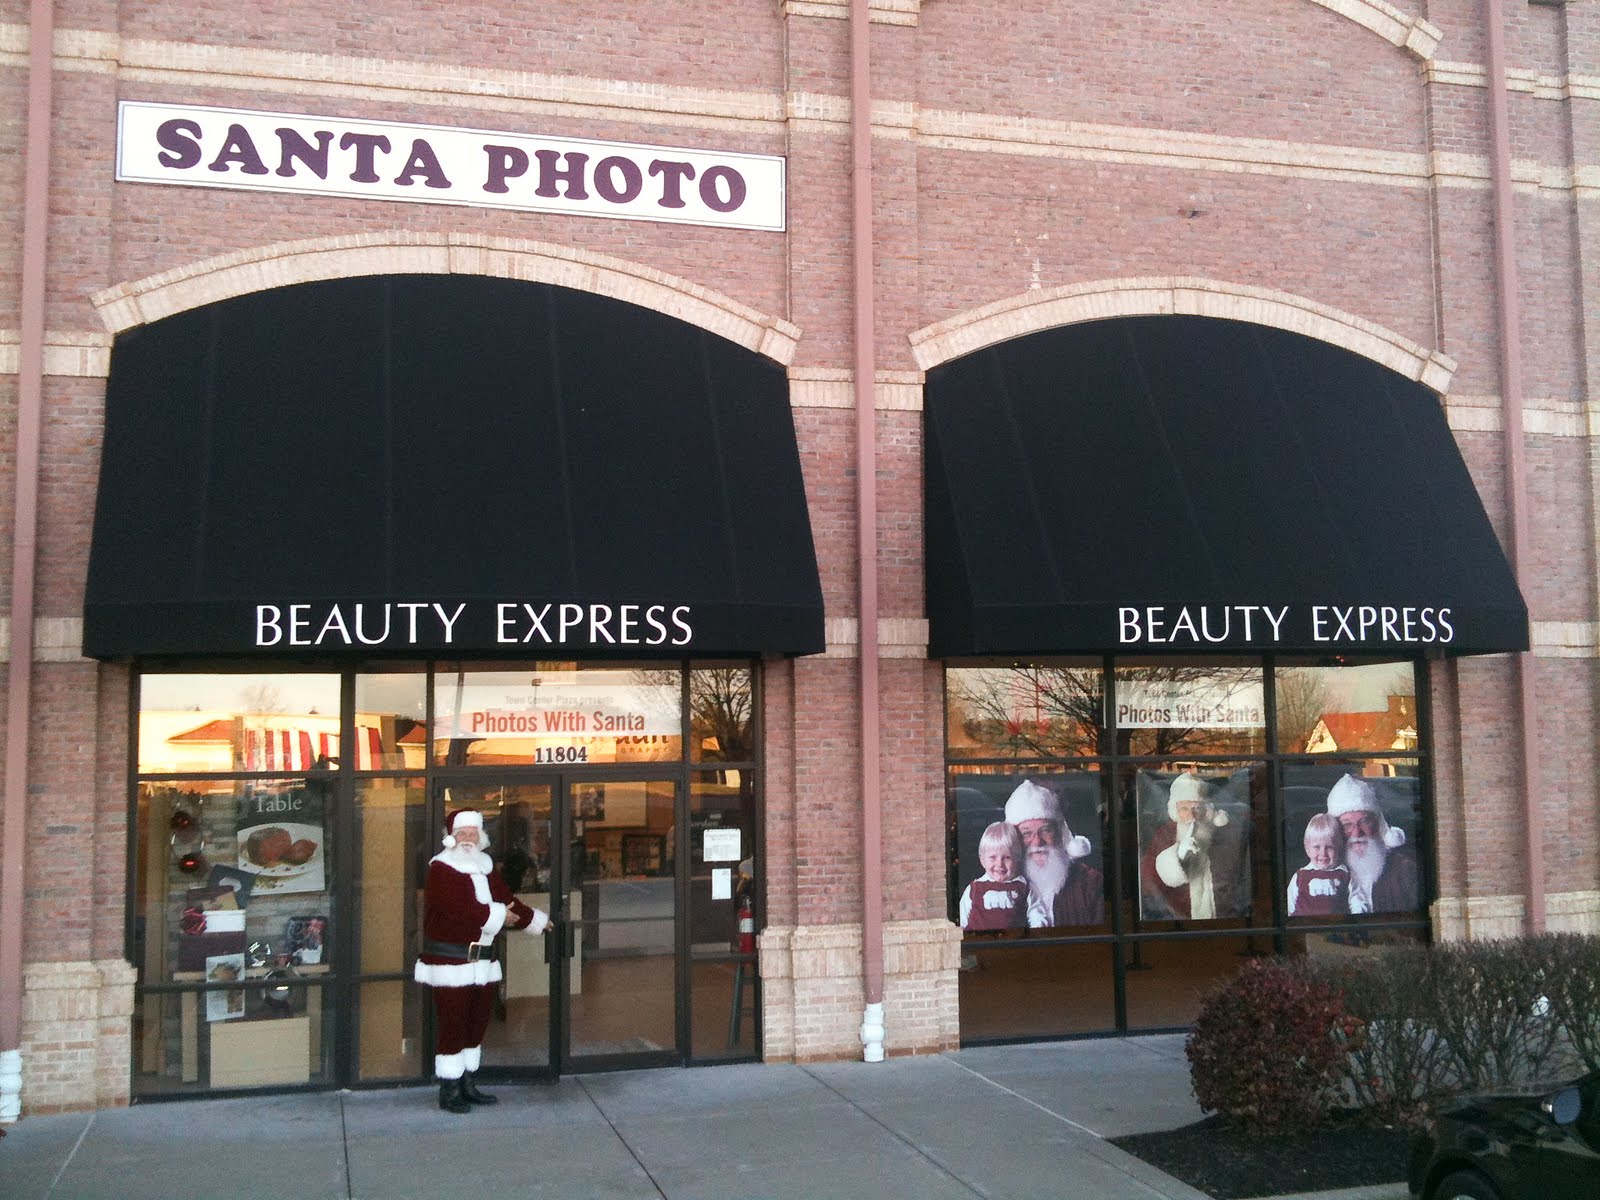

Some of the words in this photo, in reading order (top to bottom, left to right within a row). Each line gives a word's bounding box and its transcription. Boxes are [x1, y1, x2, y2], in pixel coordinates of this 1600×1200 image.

[156, 118, 452, 190] SANTA
[482, 143, 747, 213] PHOTO
[255, 603, 467, 646] BEAUTY
[496, 603, 693, 646] EXPRESS
[1118, 605, 1289, 644] BEAUTY
[1312, 605, 1455, 644] EXPRESS
[472, 711, 537, 733] Photos
[544, 711, 586, 732] With
[592, 711, 645, 732] Santa
[1118, 704, 1171, 723] Photos
[1176, 704, 1211, 723] With
[1216, 704, 1260, 723] Santa
[535, 745, 588, 764] 11804
[255, 792, 303, 813] Table
